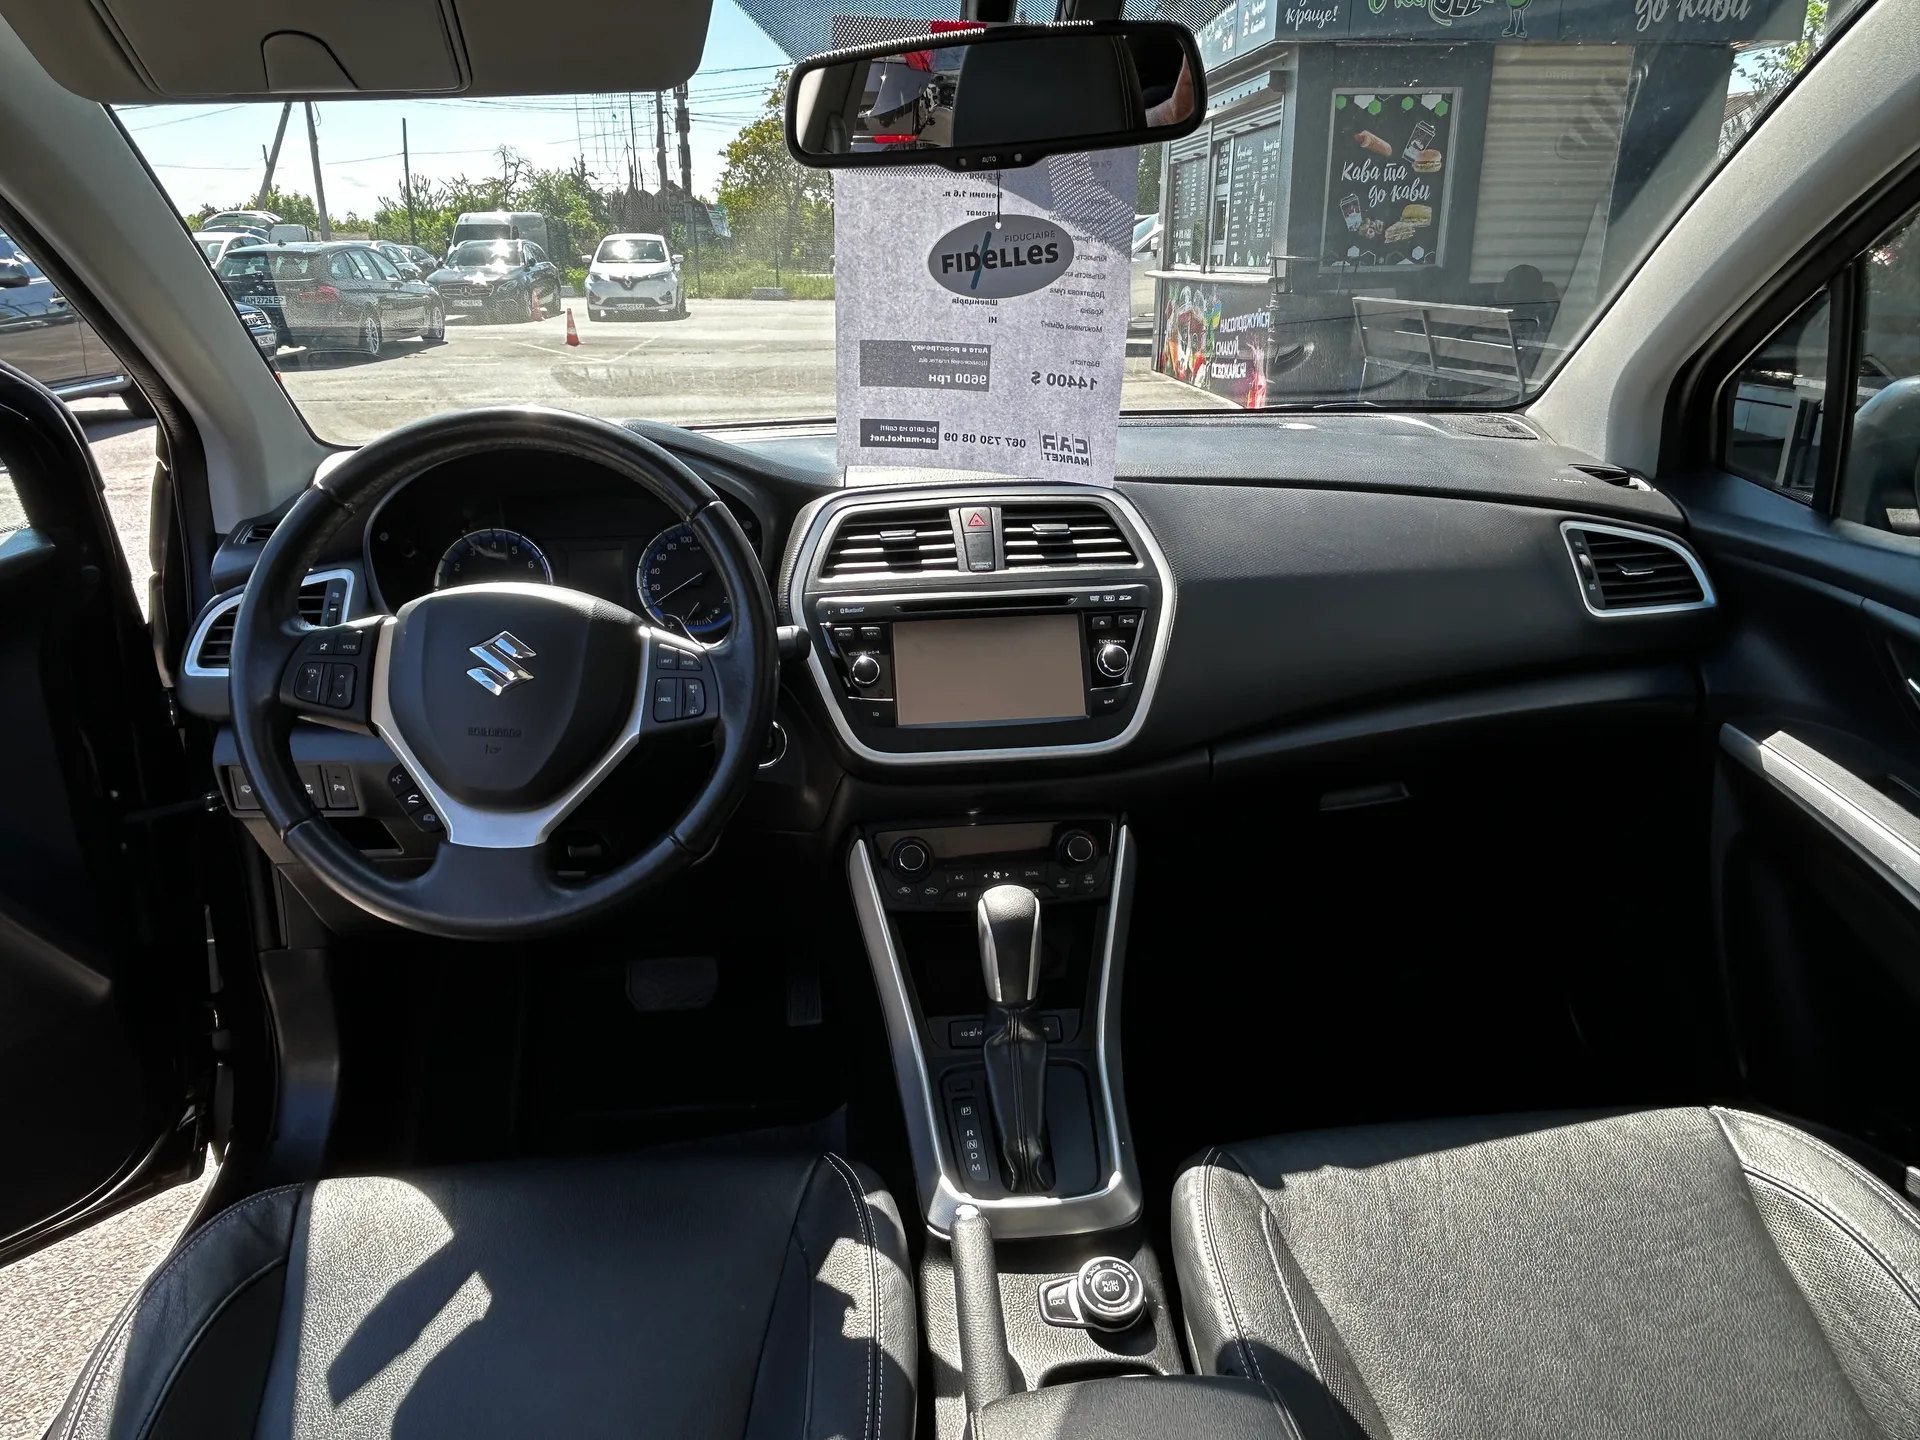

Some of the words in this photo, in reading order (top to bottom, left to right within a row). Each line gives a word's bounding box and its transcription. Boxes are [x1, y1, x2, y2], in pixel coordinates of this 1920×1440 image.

[1285, 5, 1339, 31] краще!
[1341, 158, 1381, 183] Кава
[1383, 163, 1408, 182] та
[1368, 185, 1387, 208] до
[1390, 177, 1430, 202] кави
[1004, 230, 1056, 243] FIDUCIAIRE
[511, 546, 518, 555] 5
[454, 563, 460, 571] 2
[527, 560, 534, 569] 6
[650, 583, 660, 591] 20
[966, 1129, 974, 1137] R
[1103, 1285, 1120, 1293] AUTO
[1049, 1298, 1066, 1306] LOCK
